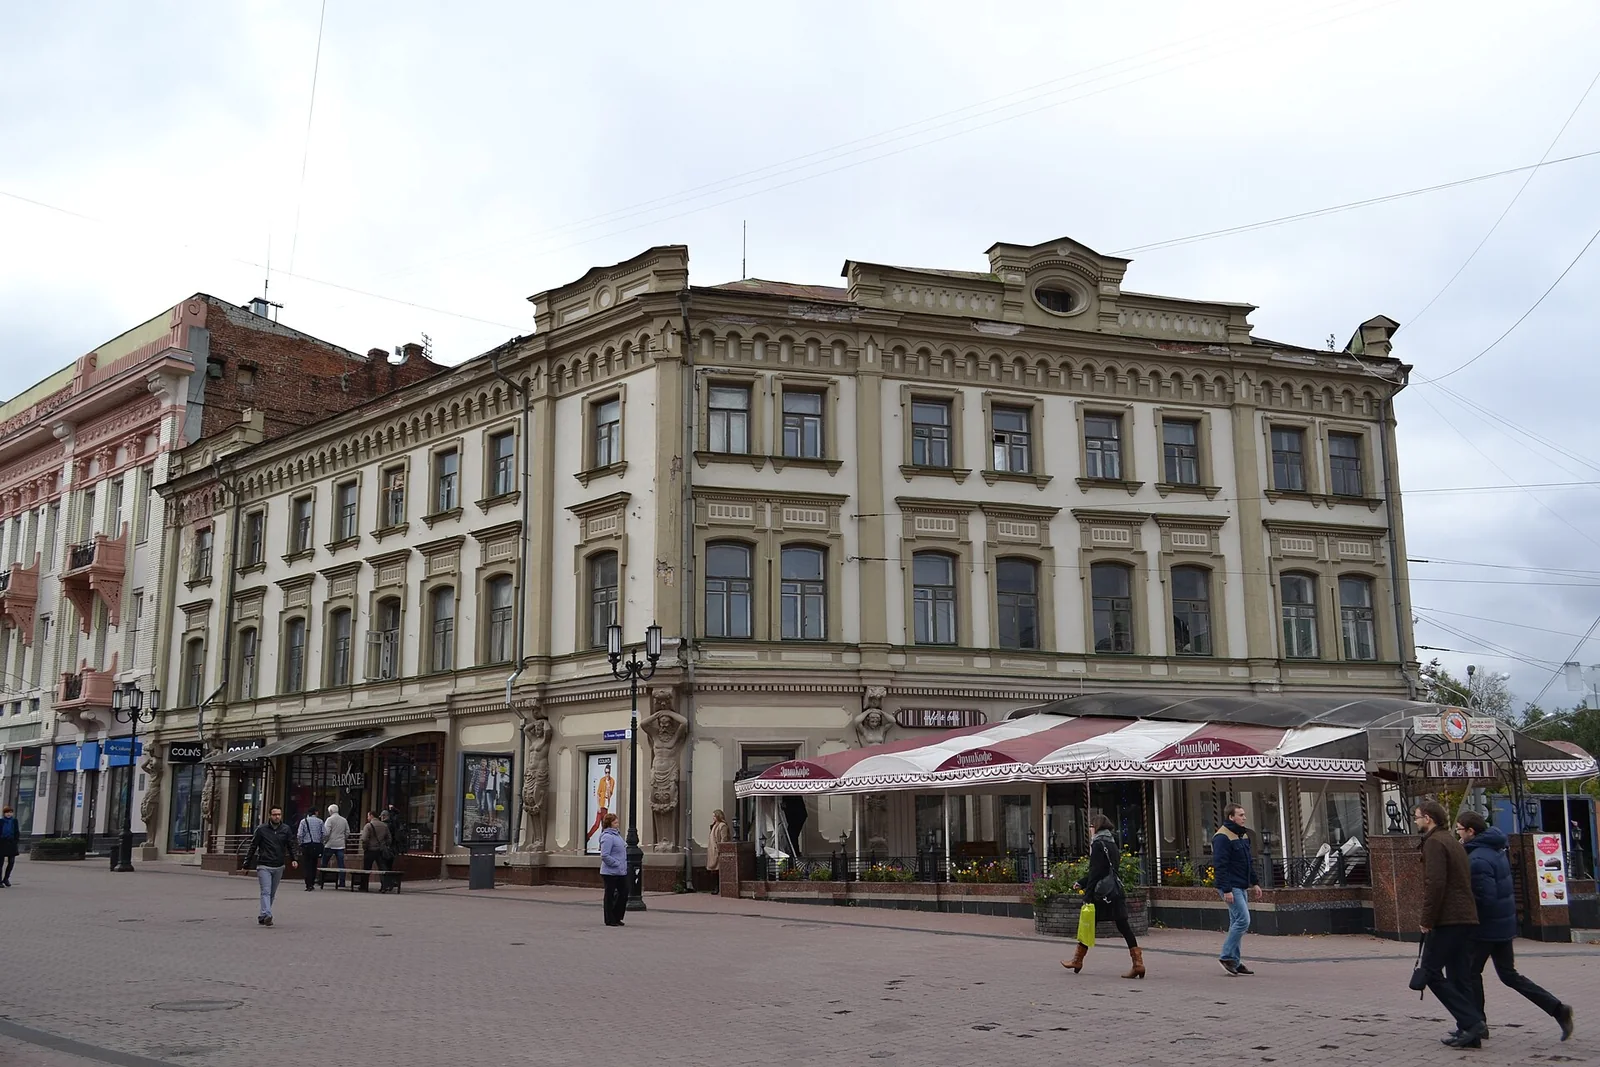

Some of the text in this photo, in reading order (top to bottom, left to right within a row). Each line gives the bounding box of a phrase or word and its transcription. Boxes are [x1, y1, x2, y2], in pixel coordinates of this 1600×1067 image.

[171, 747, 201, 757] COLIN'S
[1174, 740, 1220, 757] ЭрмиКофе
[956, 750, 993, 767] ЭрмиКофе
[332, 767, 362, 790] BARONE
[780, 766, 810, 778] ЭрмиКофе
[475, 826, 498, 834] COLIN'S
